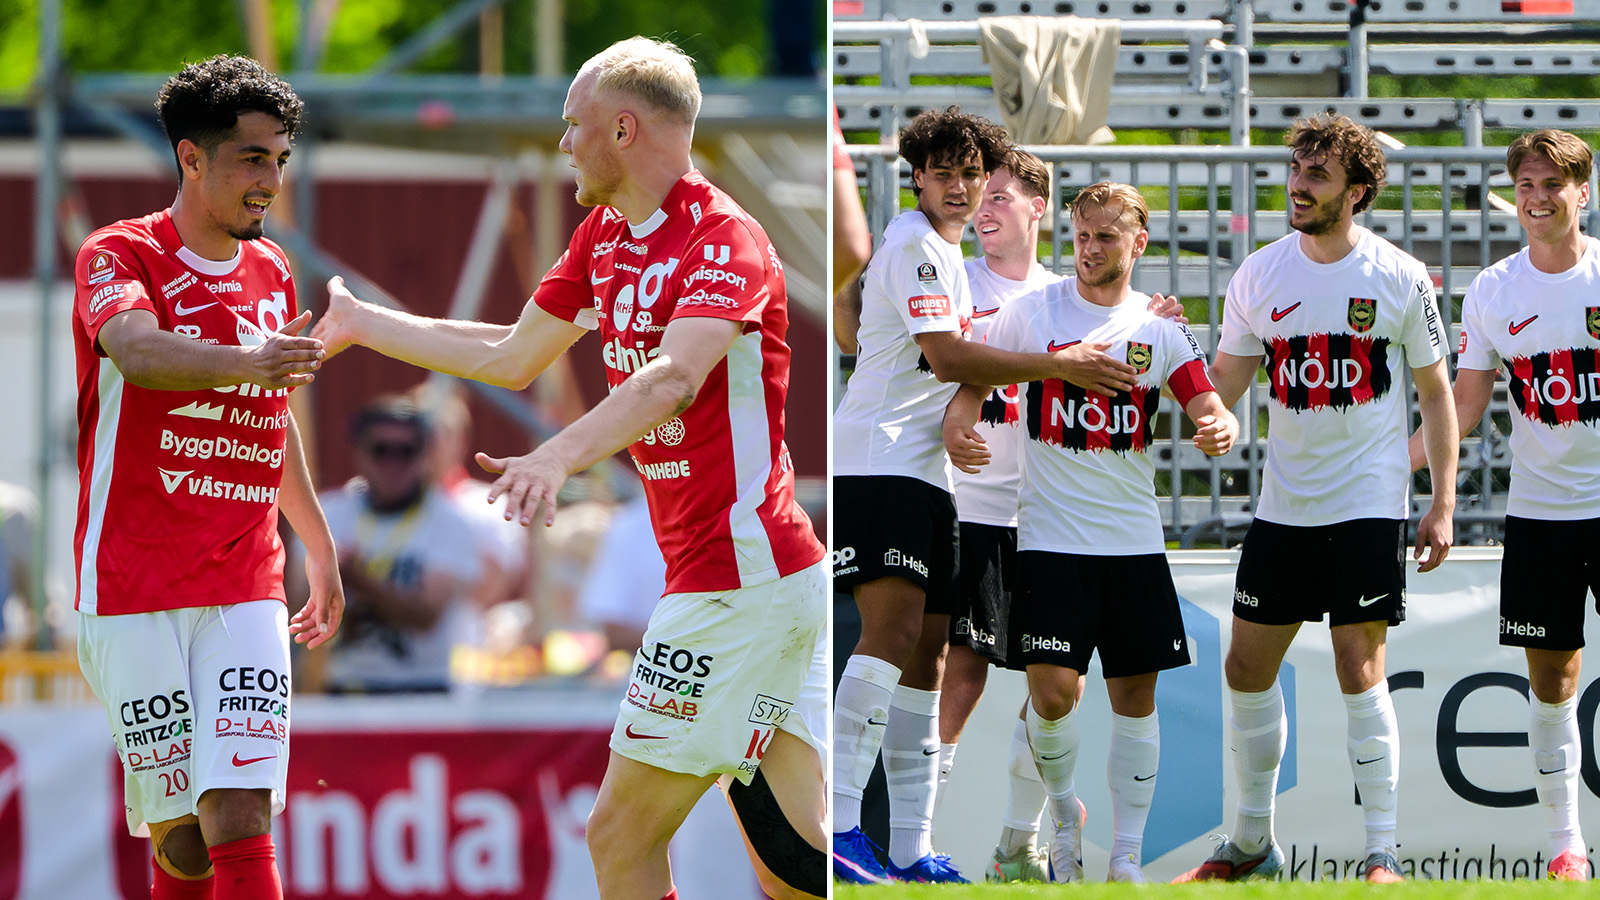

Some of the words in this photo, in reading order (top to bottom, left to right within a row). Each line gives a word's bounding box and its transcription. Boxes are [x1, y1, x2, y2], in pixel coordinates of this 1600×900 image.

[683, 265, 747, 291] unisport
[89, 284, 134, 313] UNIBET
[614, 301, 633, 314] MHE
[911, 299, 947, 310] UNIBET
[1279, 351, 1363, 390] NÖJD
[1051, 396, 1140, 435] NÖJD
[160, 429, 283, 469] ByggDialog
[188, 475, 280, 504] VÄSTANH
[903, 554, 929, 578] Heba
[1506, 620, 1546, 637] Heba
[1032, 636, 1071, 653] Heba
[219, 666, 289, 699] CEOS
[635, 663, 706, 699] FRITZOE
[120, 689, 190, 727] CEOS
[218, 695, 288, 720] FRITZOE
[627, 682, 698, 717] D-LAB
[124, 717, 192, 749] FRITZOE
[215, 717, 286, 740] D-LAB
[158, 768, 189, 798] 20
[287, 754, 523, 897] nda
